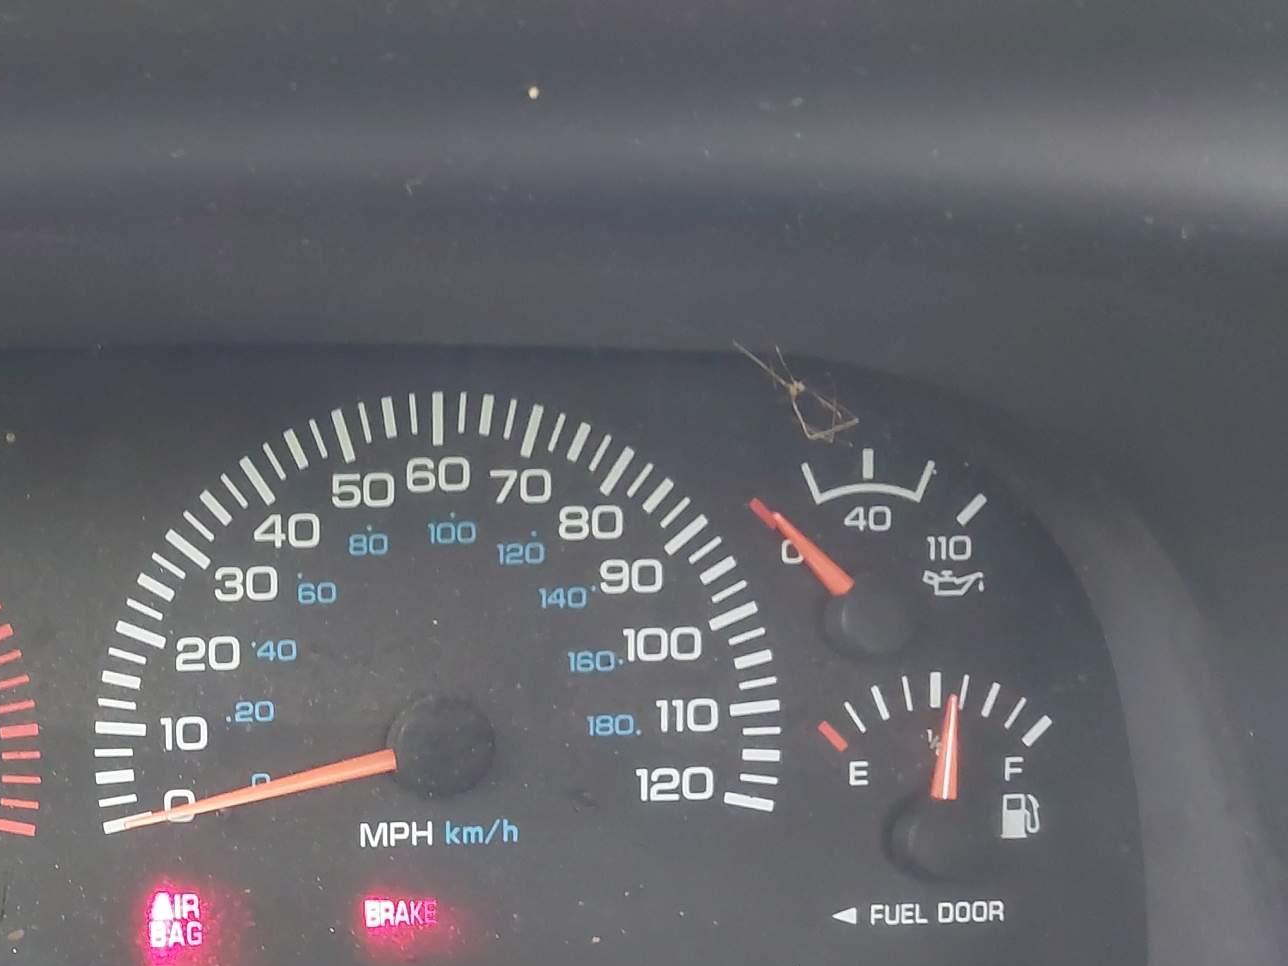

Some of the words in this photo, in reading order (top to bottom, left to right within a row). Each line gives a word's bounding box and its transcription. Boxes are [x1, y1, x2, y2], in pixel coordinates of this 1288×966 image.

[406, 456, 471, 493] 60
[489, 468, 552, 504] 70
[331, 472, 395, 508] 50
[253, 513, 321, 549] 40
[558, 505, 624, 541] 80
[843, 505, 892, 532] 40
[348, 533, 389, 556] 80
[427, 521, 476, 545] 100
[496, 542, 546, 566] 120
[926, 535, 972, 561] 110
[214, 566, 279, 602] 30
[599, 558, 663, 594] 90
[297, 582, 337, 604] 60
[538, 586, 587, 609] 140
[175, 636, 241, 672] 20
[256, 639, 297, 662] 40
[623, 627, 702, 662] 100
[567, 650, 615, 673] 160
[234, 700, 275, 723] 20
[655, 698, 720, 733] 110
[161, 716, 208, 751] 10
[586, 714, 634, 737] 180
[849, 761, 869, 786] E
[1004, 756, 1024, 782] F
[635, 766, 714, 802] 120
[359, 821, 433, 848] MPH
[445, 818, 519, 845] km/h
[152, 891, 200, 921] AIR
[365, 900, 438, 928] BRAKE
[870, 903, 929, 926] FUEL
[937, 901, 1004, 925] DOOR
[149, 921, 203, 948] BAG
